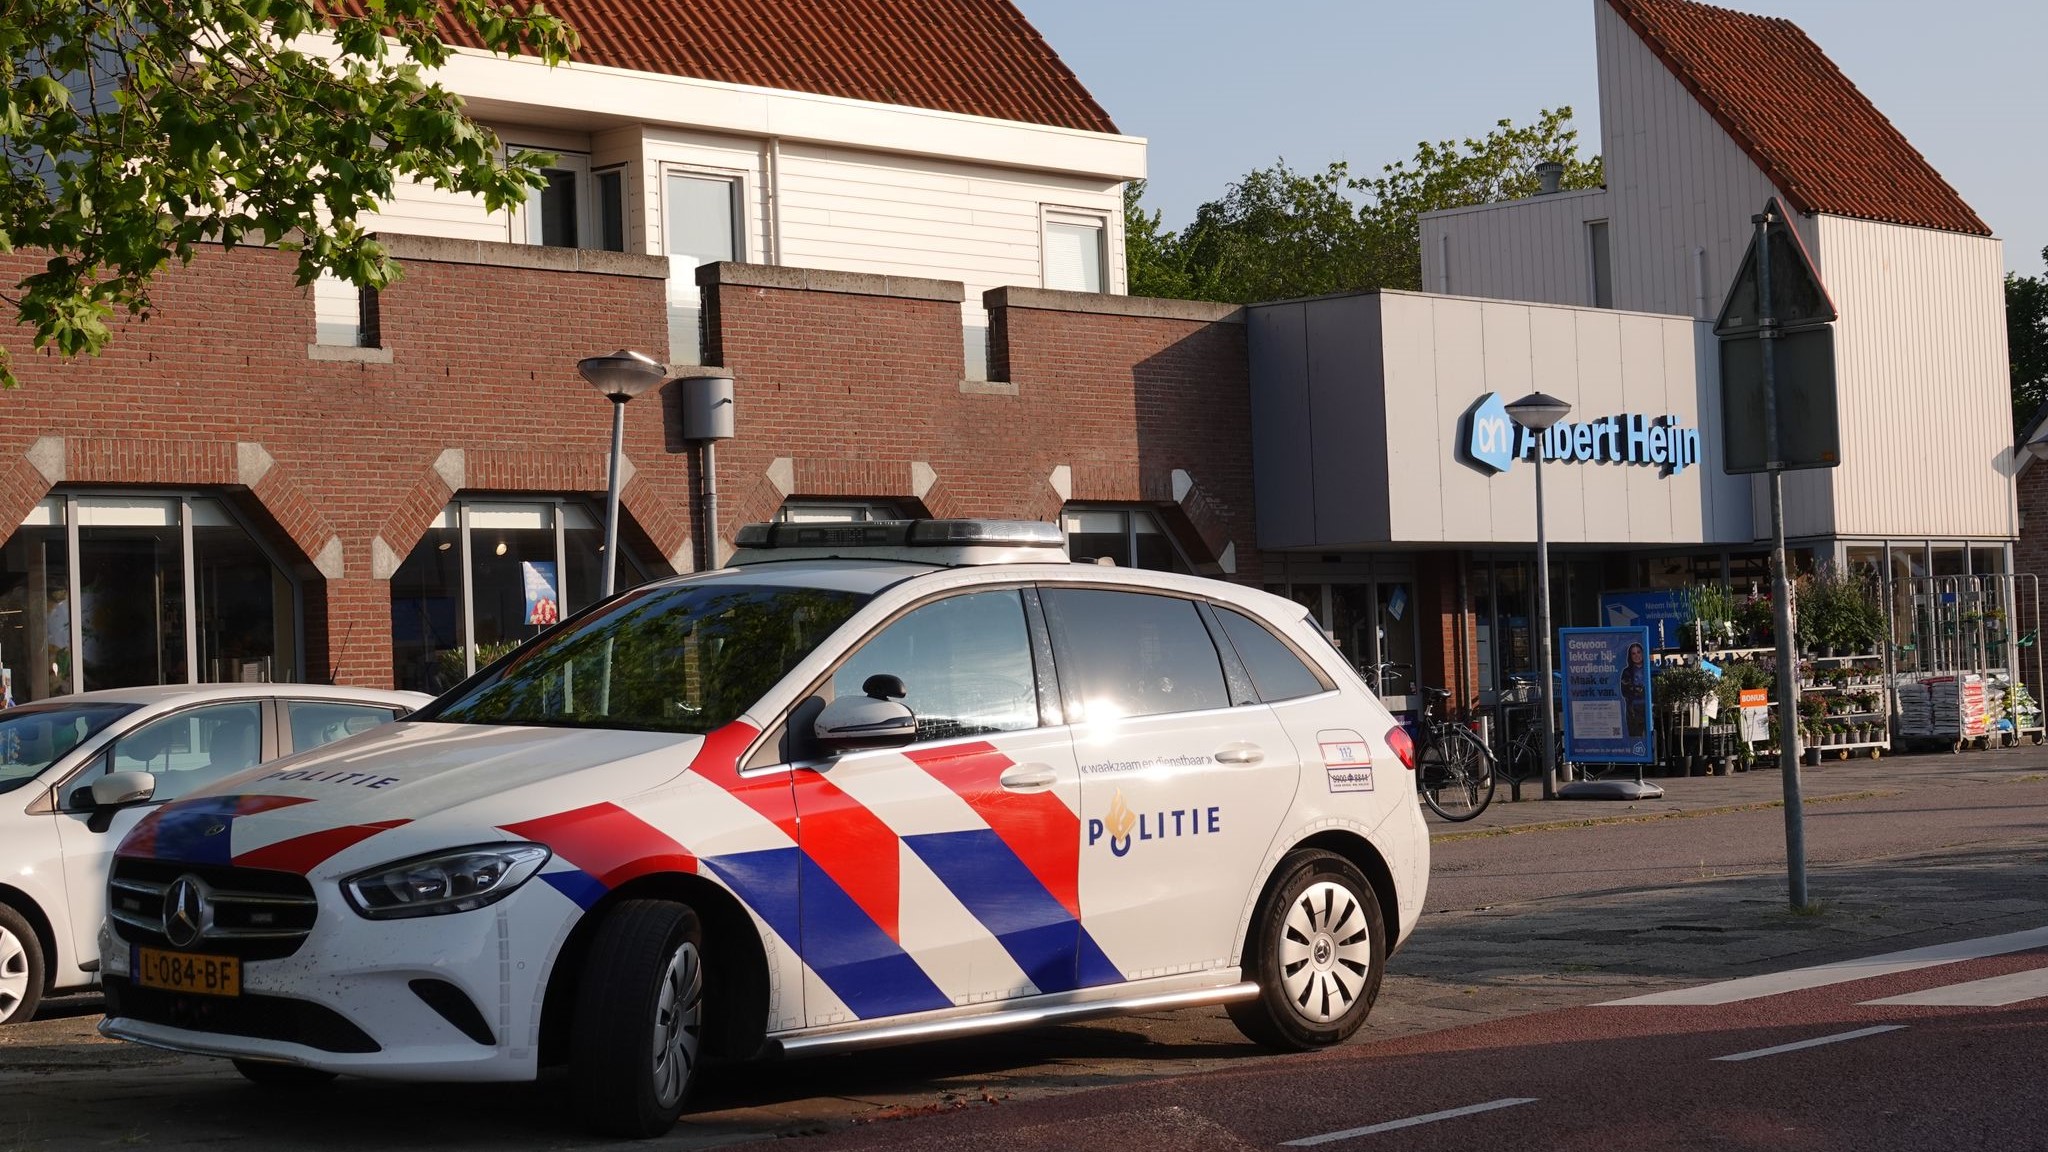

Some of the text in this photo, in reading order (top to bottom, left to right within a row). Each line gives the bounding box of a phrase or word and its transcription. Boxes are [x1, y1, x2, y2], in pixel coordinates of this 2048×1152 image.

[1627, 413, 1701, 475] Heijn
[1568, 640, 1607, 650] Gewoon
[1569, 650, 1617, 663] lekker bij-
[1569, 662, 1618, 674] verdienen.
[1570, 675, 1609, 685] Maak er
[1571, 687, 1618, 698] werk van.
[1741, 693, 1765, 703] BONUS
[1338, 746, 1353, 758] 112
[1089, 759, 1142, 774] waakzaam
[1155, 754, 1205, 768] dienstbaar
[257, 771, 400, 789] POLITIE
[1089, 806, 1220, 857] POLITIE
[145, 953, 231, 990] L-084-BF
